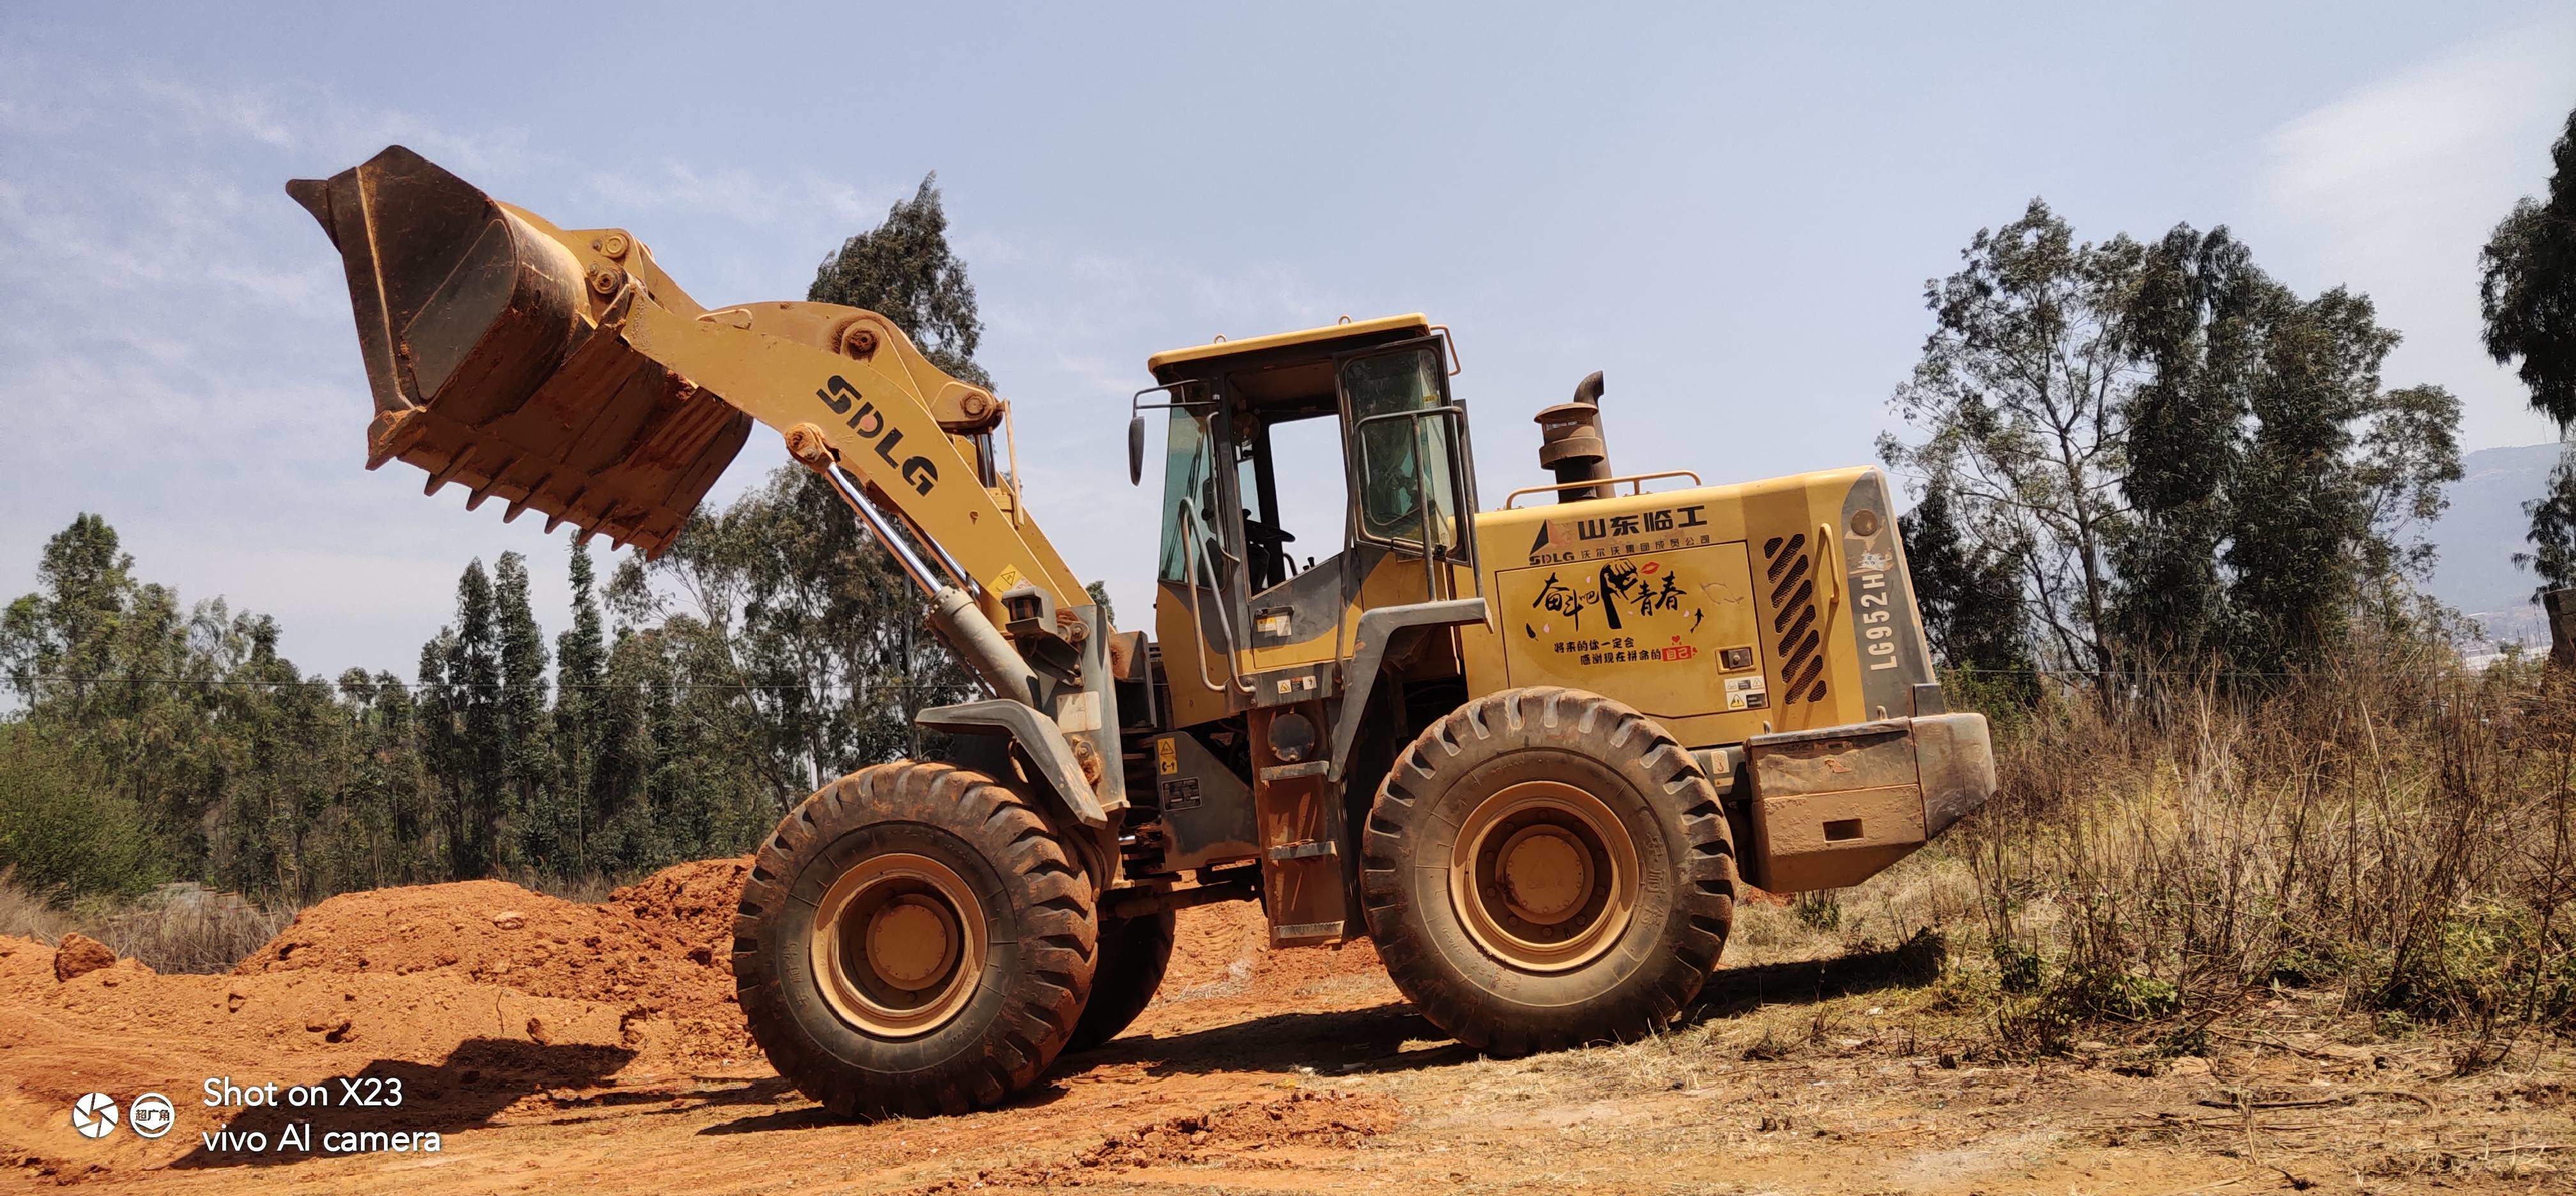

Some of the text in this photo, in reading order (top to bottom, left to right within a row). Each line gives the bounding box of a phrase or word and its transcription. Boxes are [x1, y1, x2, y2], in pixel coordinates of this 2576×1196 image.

[816, 375, 939, 497] SDLG
[1577, 505, 1708, 540] 山东临工
[1529, 551, 1575, 565] SDLG
[1581, 534, 1710, 559] 沃尔沃集团成员公司
[1860, 573, 1898, 670] LG952H
[1554, 637, 1635, 654] 将来的你一定会
[1580, 646, 1691, 665] 感谢现在拼命的自己
